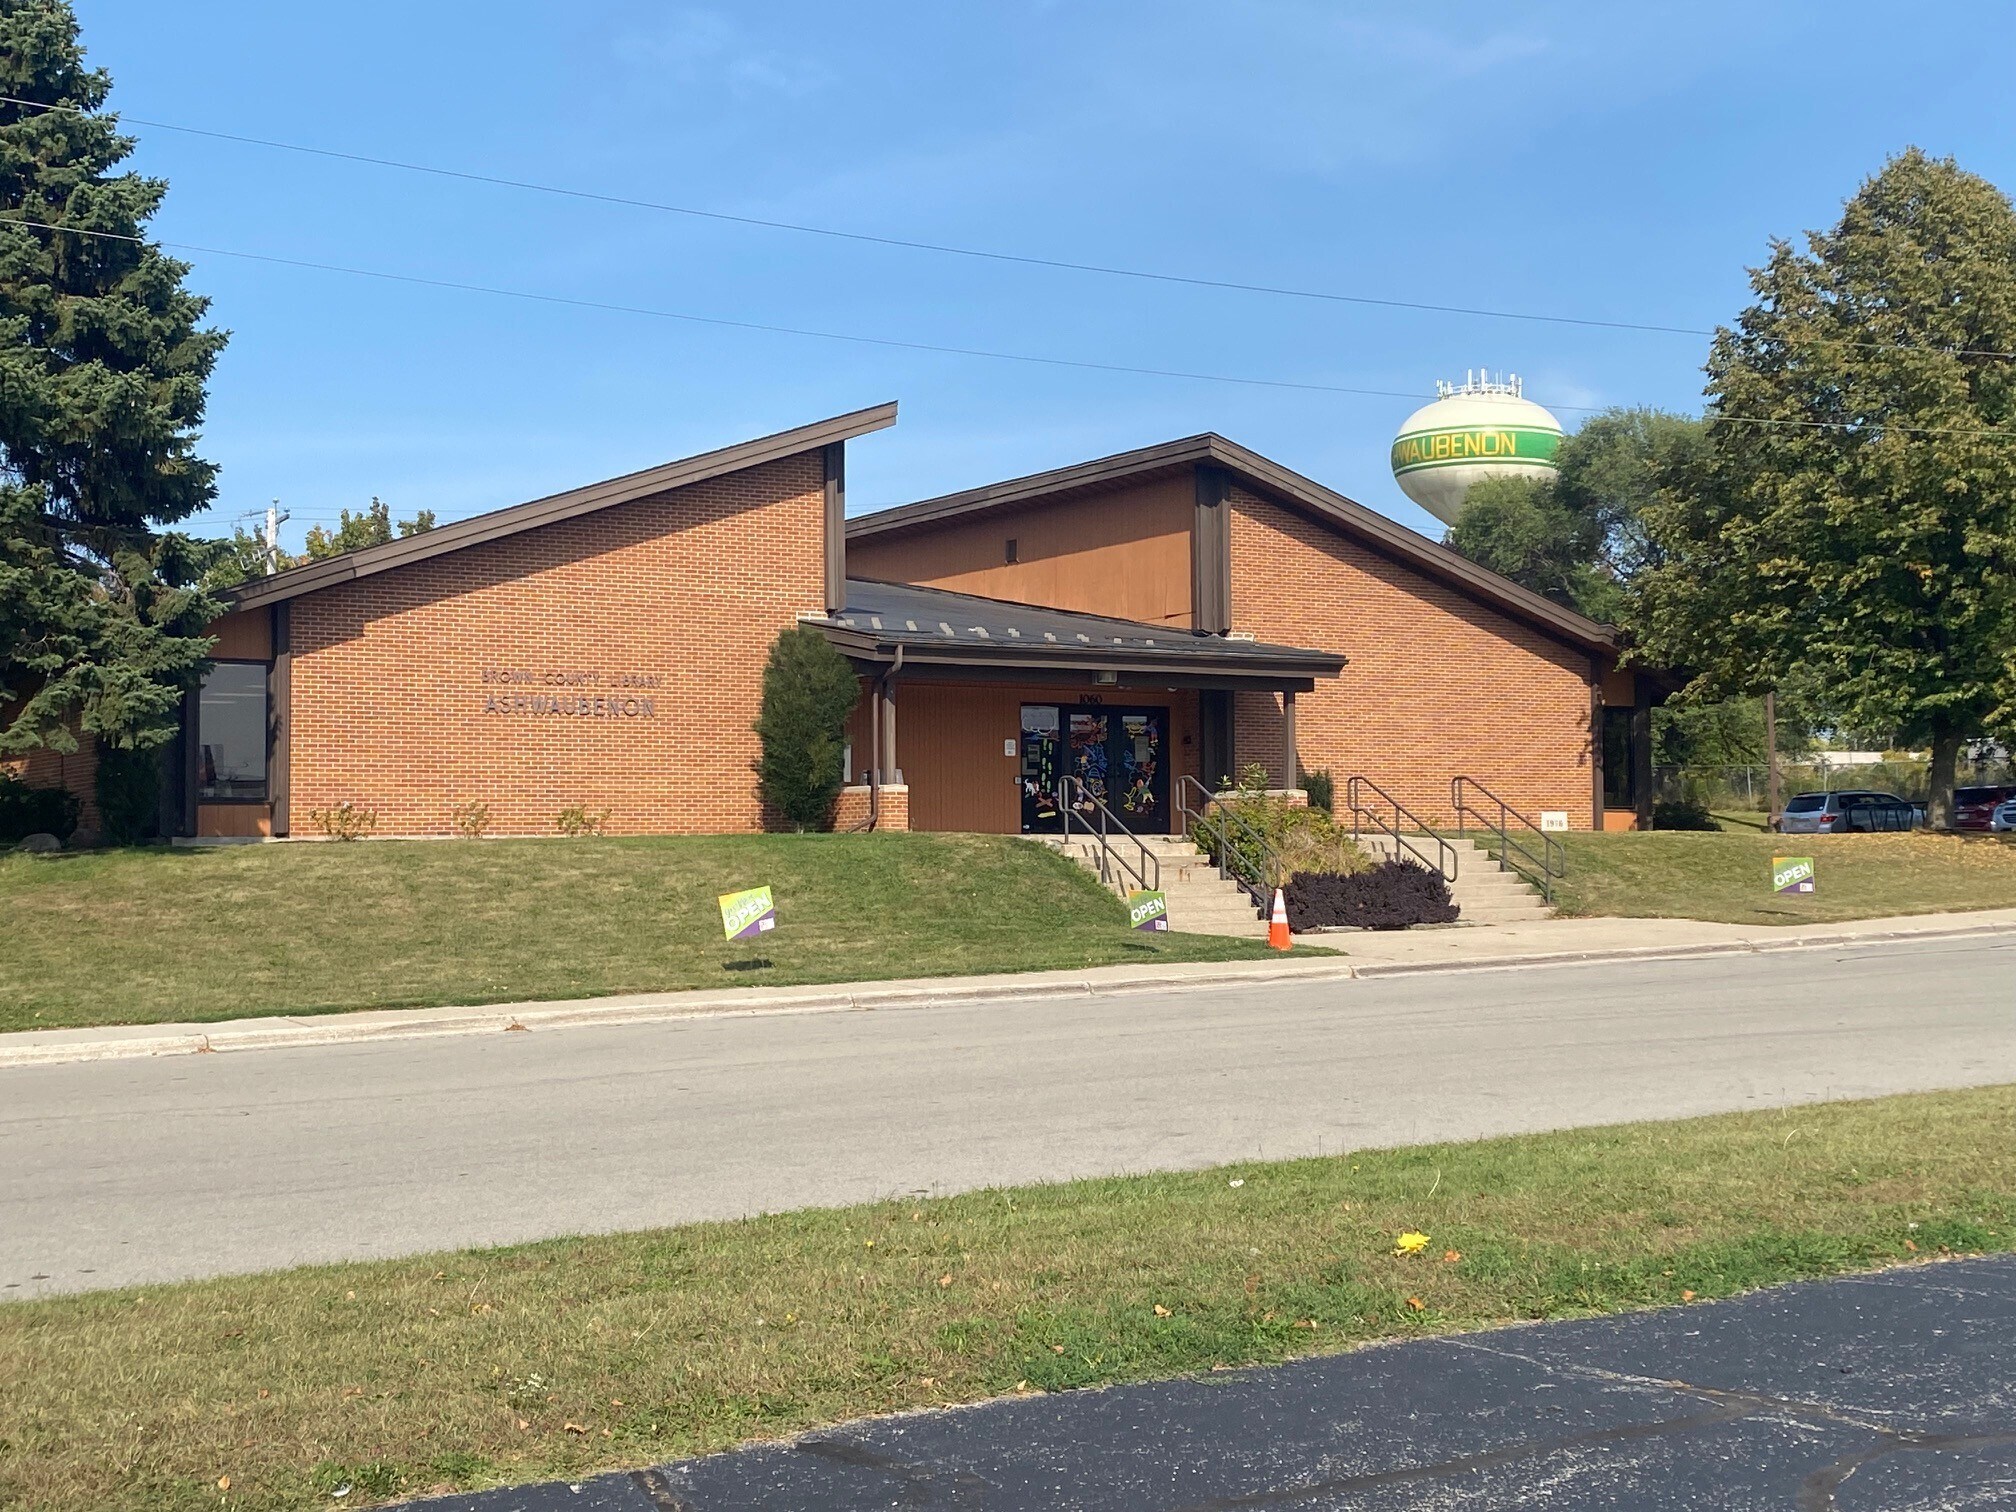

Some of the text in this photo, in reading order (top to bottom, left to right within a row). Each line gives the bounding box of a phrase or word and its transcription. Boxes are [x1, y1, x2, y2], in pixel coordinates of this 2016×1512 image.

[482, 670, 662, 688] BROWN COUNTY LIBRARY
[485, 694, 655, 718] ASHWAUBENON
[1079, 694, 1103, 704] 1060
[1773, 862, 1810, 887] OPEN
[725, 891, 771, 932] OPEN
[1130, 896, 1165, 922] OPEN
